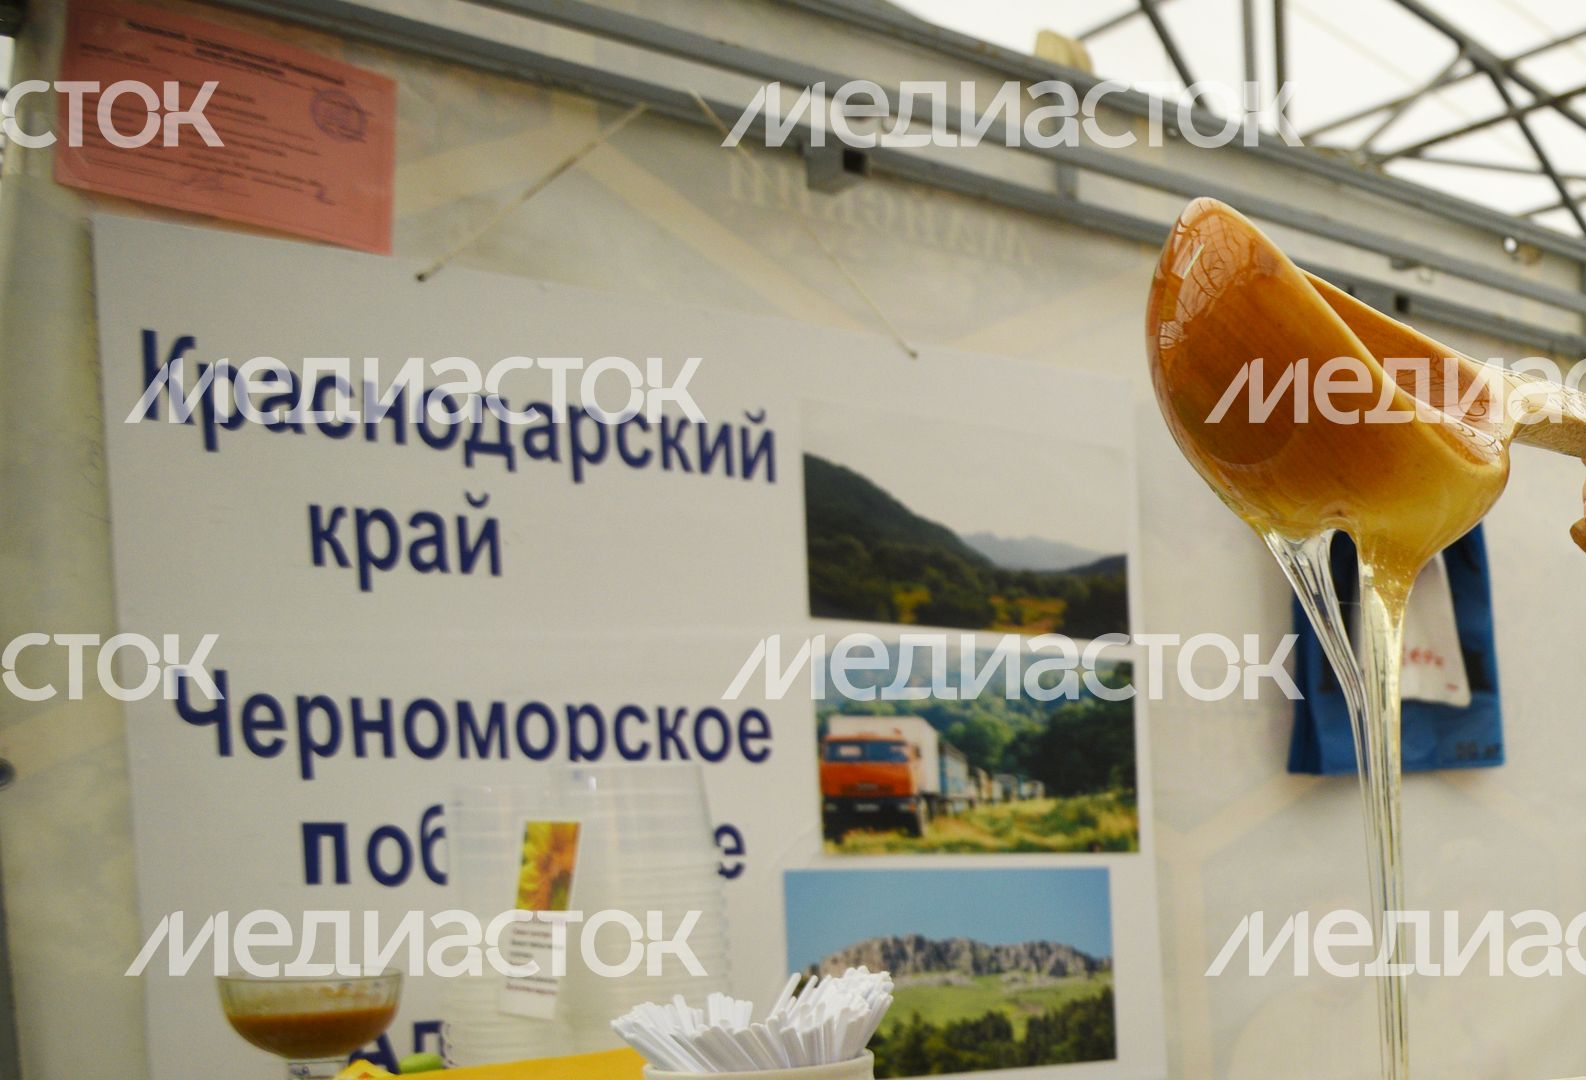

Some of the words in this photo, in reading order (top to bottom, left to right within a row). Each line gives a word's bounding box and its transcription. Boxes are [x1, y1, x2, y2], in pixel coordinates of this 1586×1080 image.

[140, 328, 778, 485] Краснодарский
[308, 492, 503, 592] край
[172, 667, 774, 782] Черноморское
